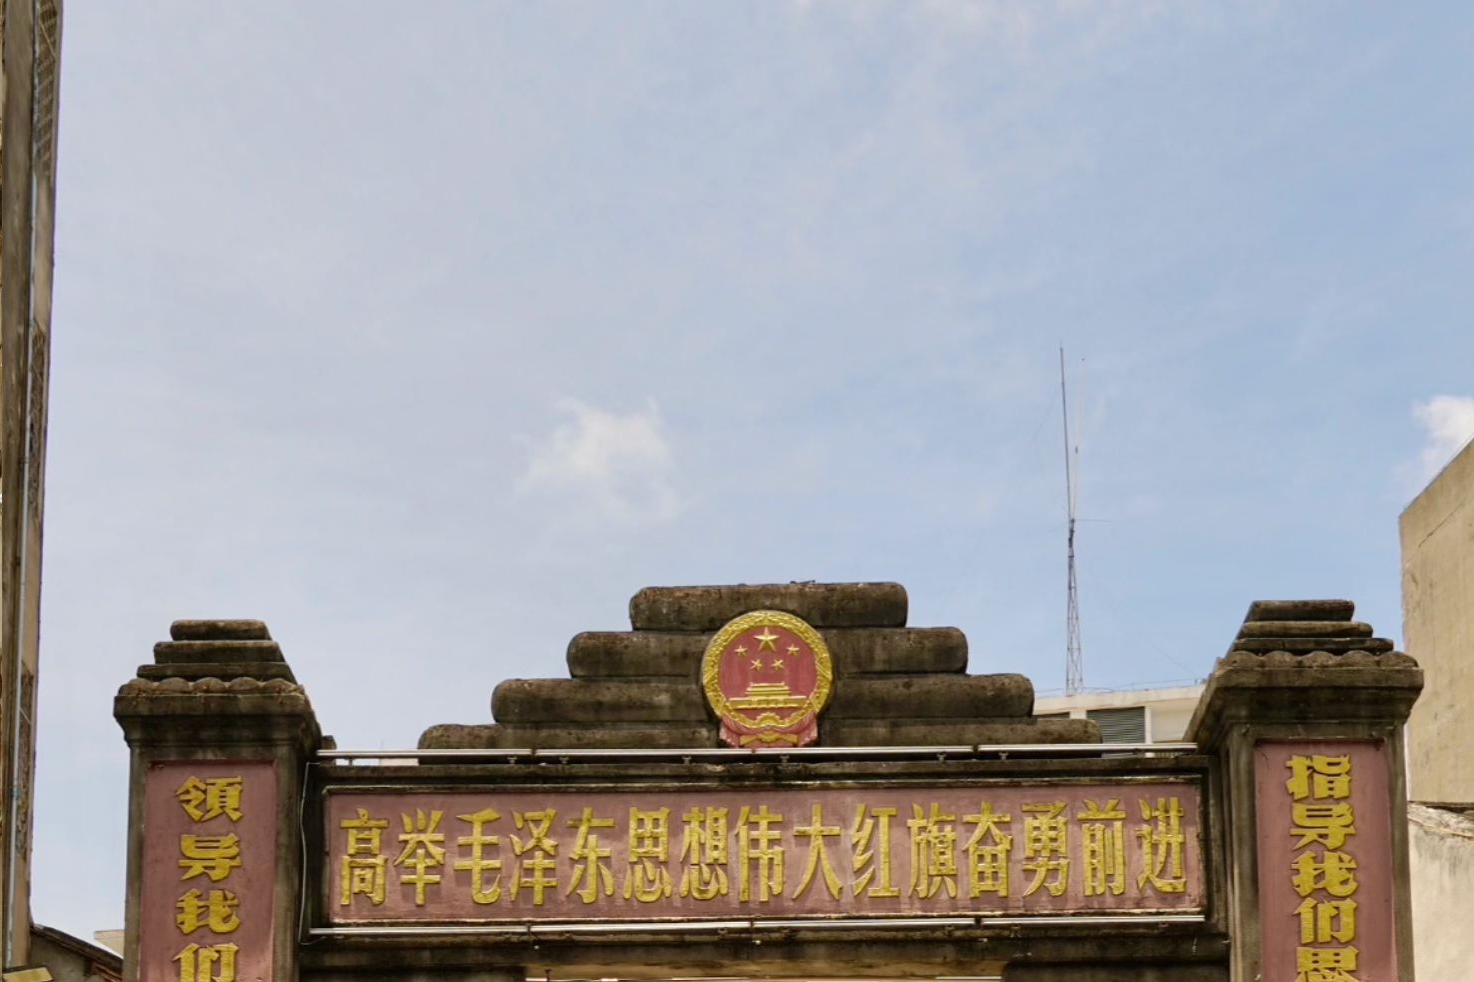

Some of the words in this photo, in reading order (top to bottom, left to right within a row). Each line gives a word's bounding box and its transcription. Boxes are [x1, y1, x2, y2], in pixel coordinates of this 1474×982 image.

[340, 797, 1188, 906] 高举毛泽东思想伟大红旗奋勇前进
